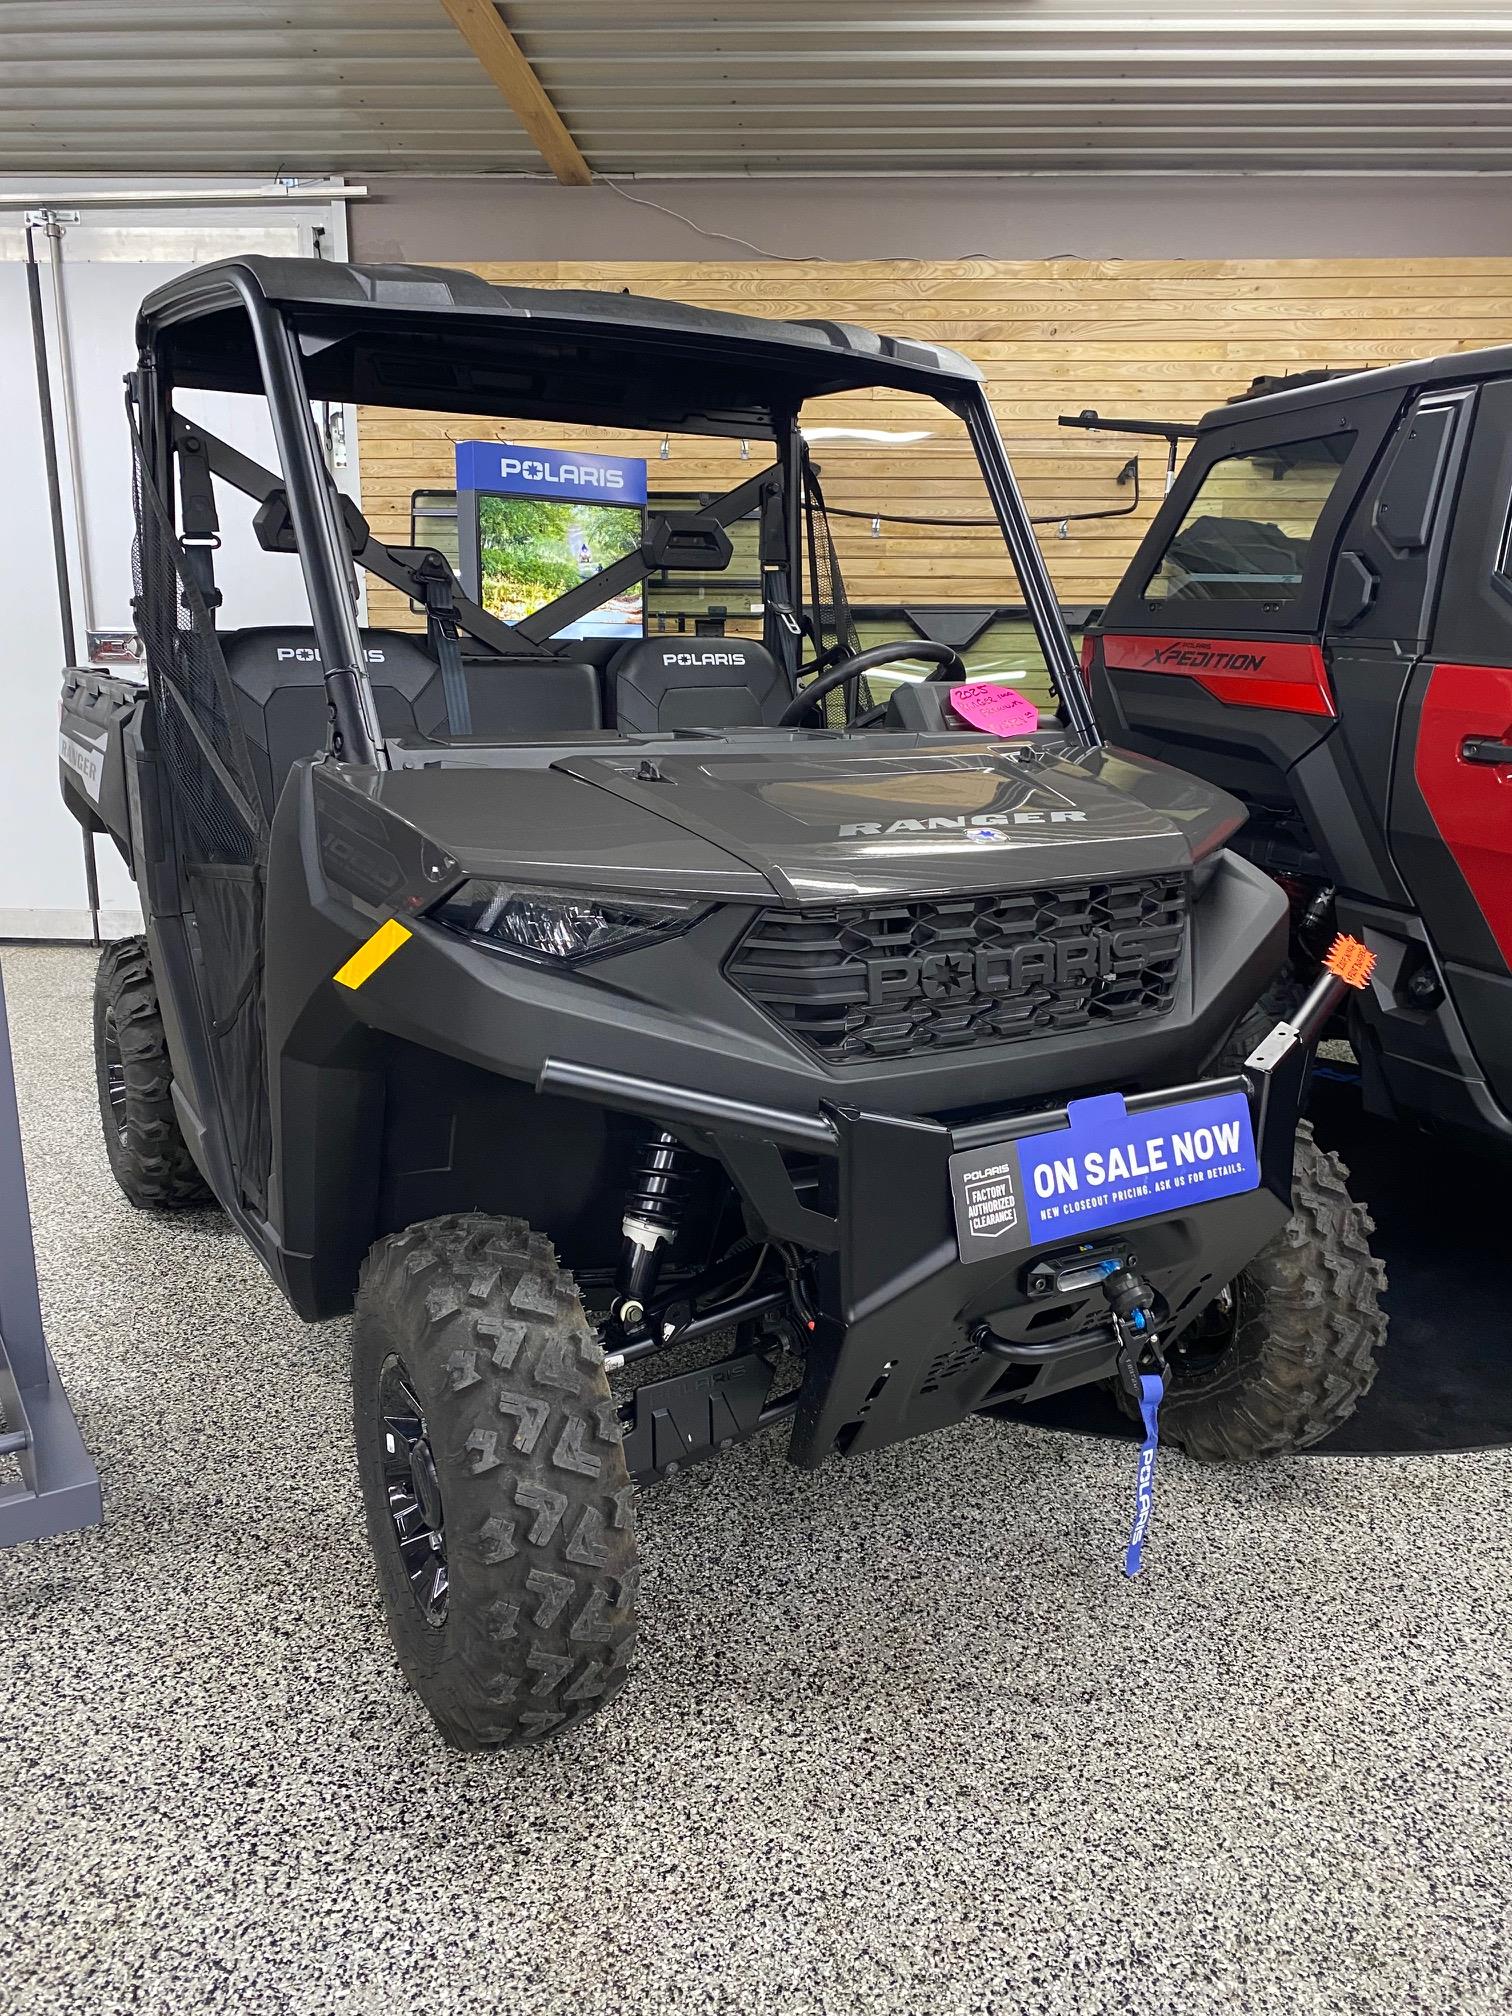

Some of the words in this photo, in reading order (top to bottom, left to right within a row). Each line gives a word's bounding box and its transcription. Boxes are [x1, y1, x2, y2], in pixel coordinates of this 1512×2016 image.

[500, 458, 624, 489] POLARIS
[276, 648, 386, 663] POLIS
[1141, 642, 1267, 671] XPEDITION
[1182, 642, 1212, 650] POLARIS
[663, 653, 746, 666] POLARIS
[955, 684, 988, 700] 2025
[62, 740, 97, 781] RANGER
[838, 811, 1088, 837] RANGER
[867, 927, 1150, 1005] POLARIS
[1033, 1157, 1079, 1199] ON
[1084, 1137, 1167, 1186] SALE
[1172, 1121, 1240, 1166] NOW
[963, 1164, 1010, 1182] POLARIS
[971, 1183, 1006, 1203] FACTORY
[1040, 1205, 1060, 1221] NEW
[1063, 1194, 1109, 1215] CLOSEOUT
[1112, 1184, 1152, 1203] PRICING.
[1155, 1180, 1172, 1193] ASK
[1174, 1177, 1186, 1188] US
[1188, 1172, 1205, 1185] FOR
[1207, 1162, 1246, 1181] DETAILS.
[968, 1196, 1015, 1219] AUTHORIZED
[973, 1209, 1014, 1229] CLEARANCE
[1132, 1448, 1153, 1546] POLARIS
